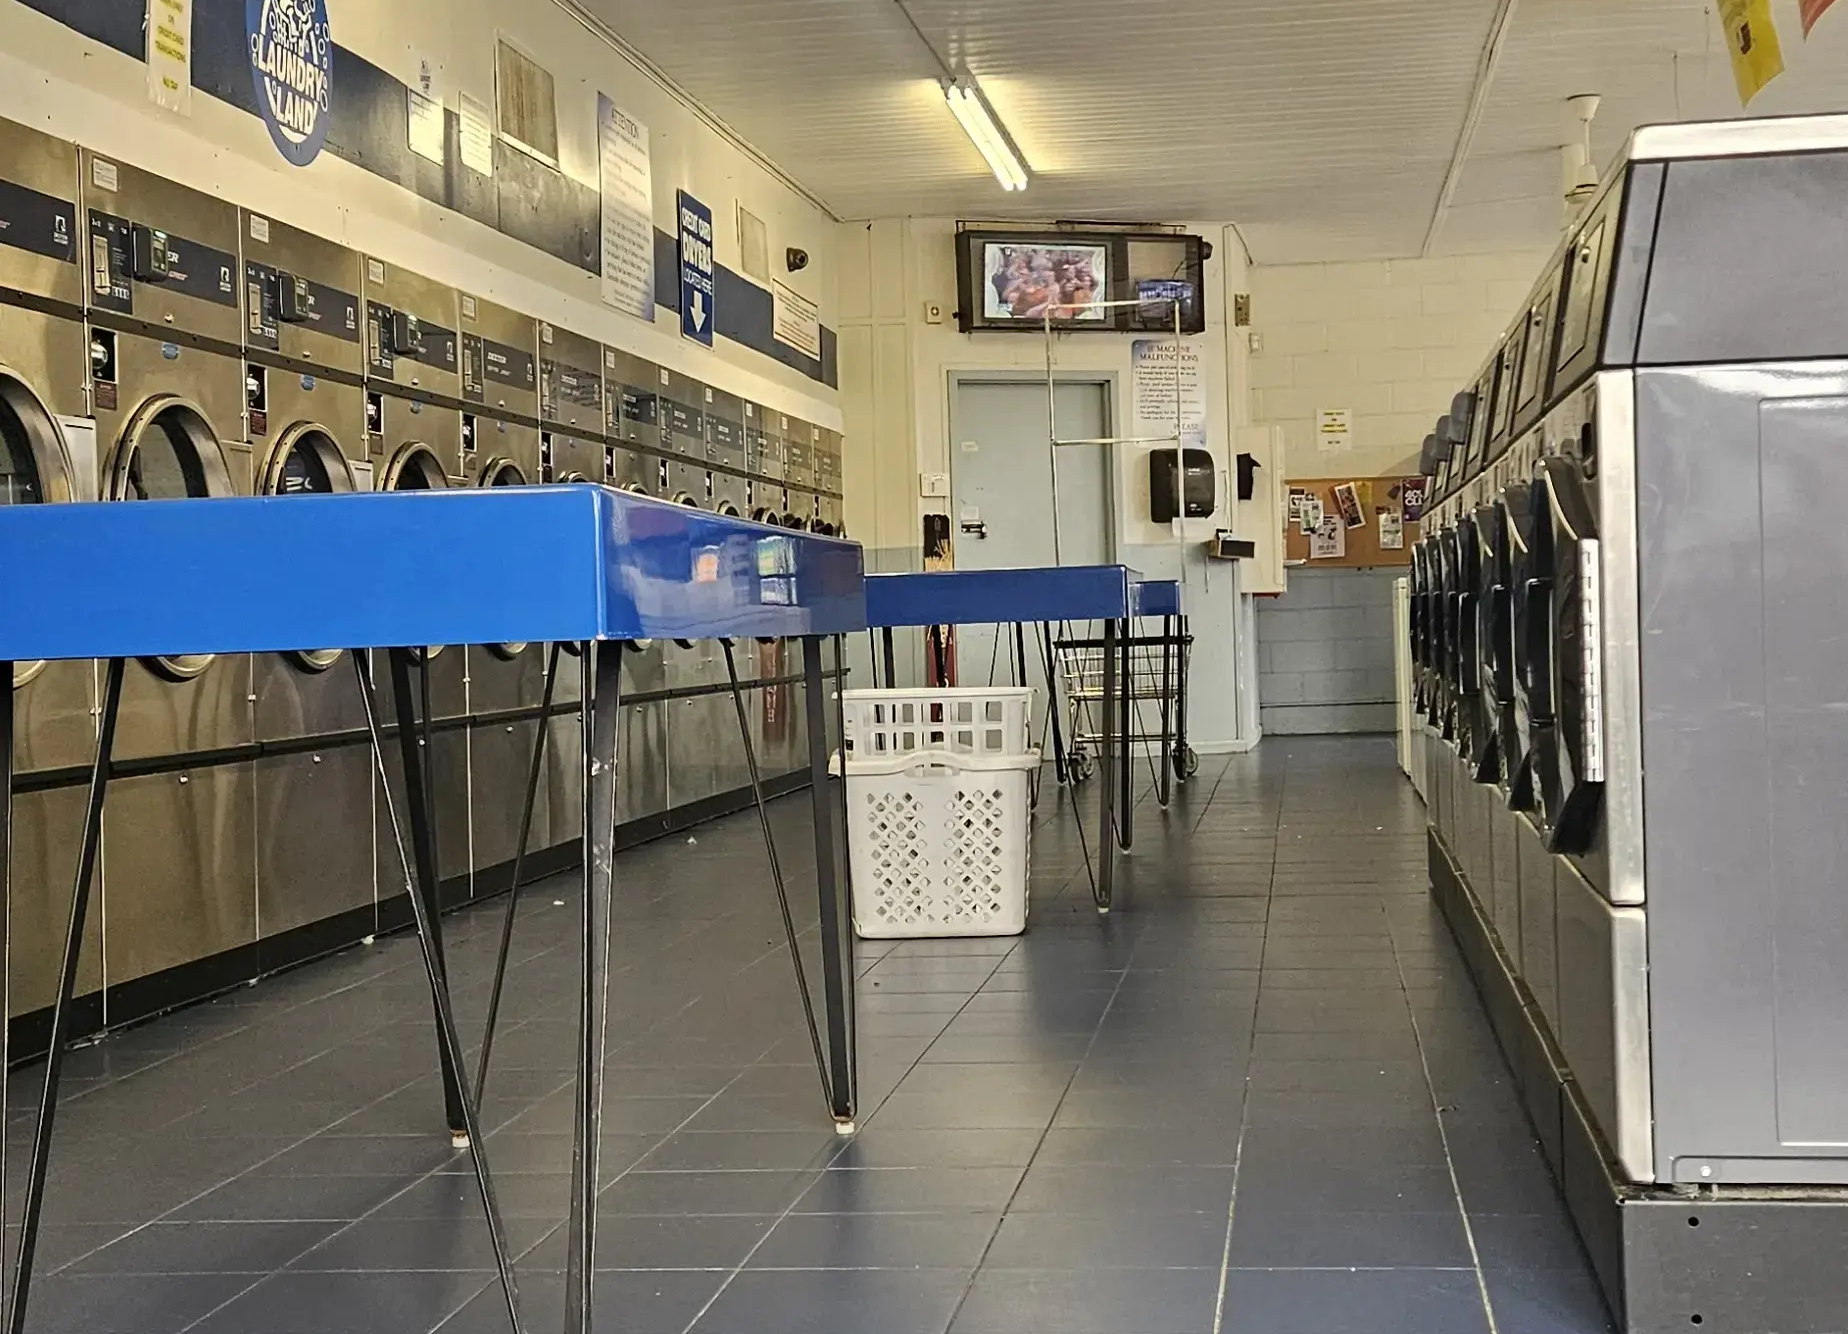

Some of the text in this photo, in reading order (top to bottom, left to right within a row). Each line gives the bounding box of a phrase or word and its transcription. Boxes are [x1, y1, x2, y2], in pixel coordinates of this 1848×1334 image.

[258, 34, 325, 103] LAUNDRY
[276, 86, 316, 136] LAND
[682, 230, 712, 277] DRYERS
[1139, 353, 1199, 362] MALFUNCIONS
[1156, 345, 1191, 354] MACNE
